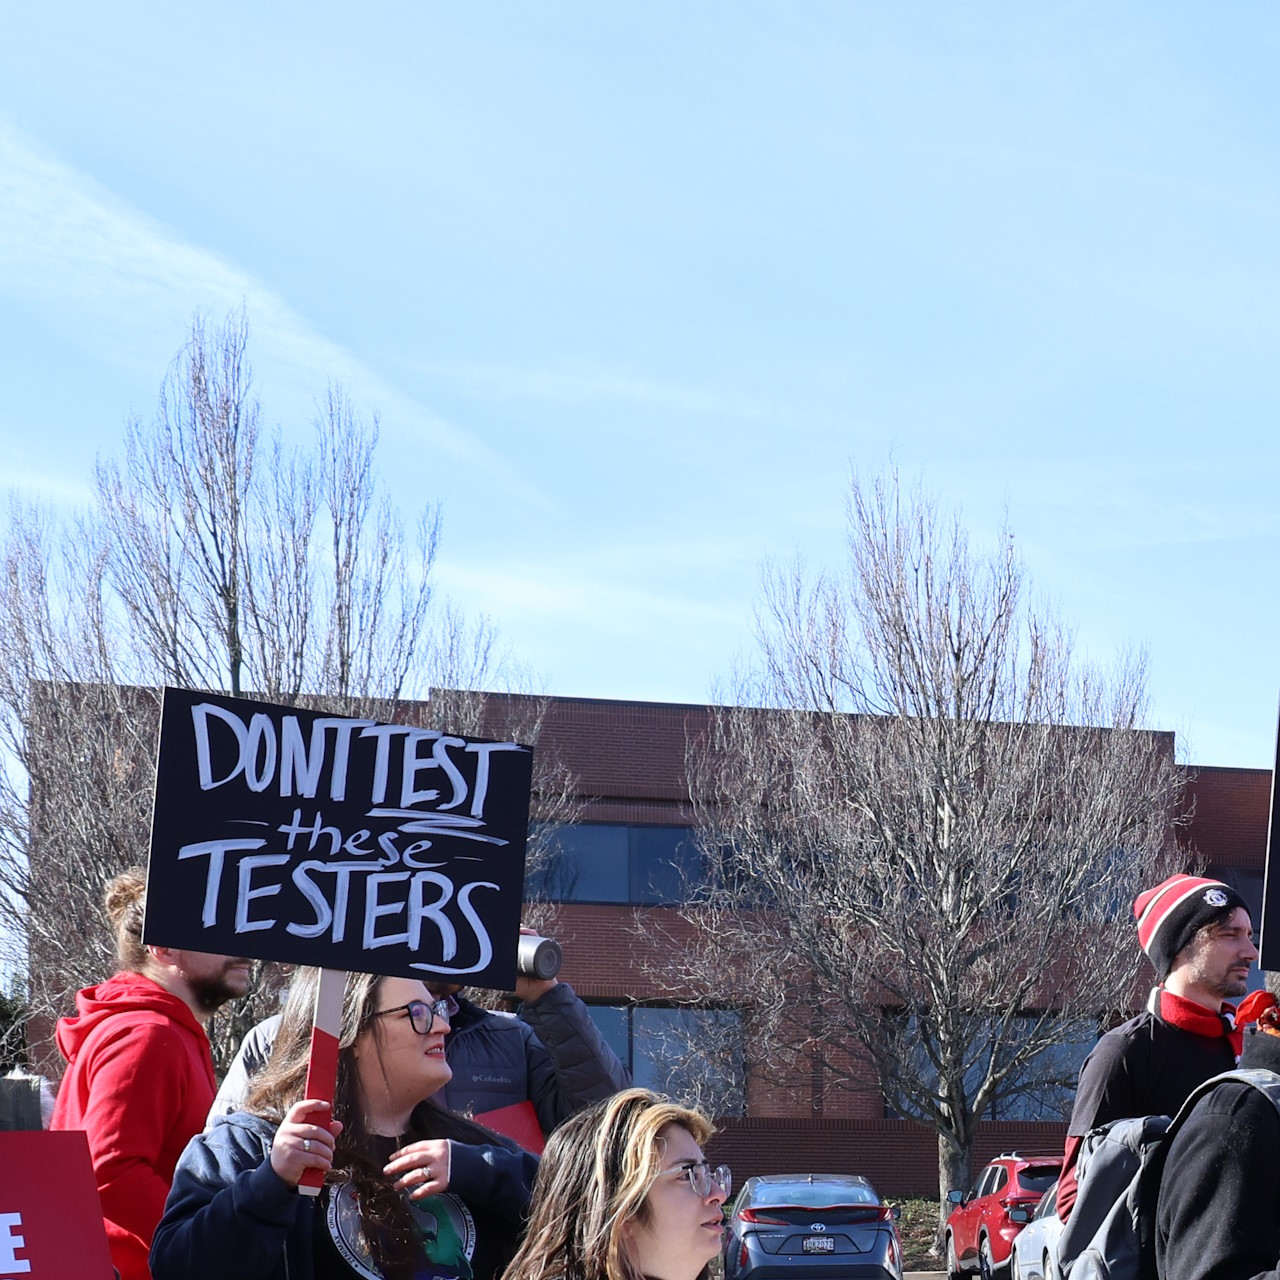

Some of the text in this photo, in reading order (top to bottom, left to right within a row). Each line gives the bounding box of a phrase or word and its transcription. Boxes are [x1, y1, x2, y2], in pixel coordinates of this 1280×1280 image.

[359, 724, 533, 819] TEST
[277, 808, 448, 868] these
[177, 838, 500, 975] TESTERS
[333, 1235, 356, 1265] ZENIMAX
